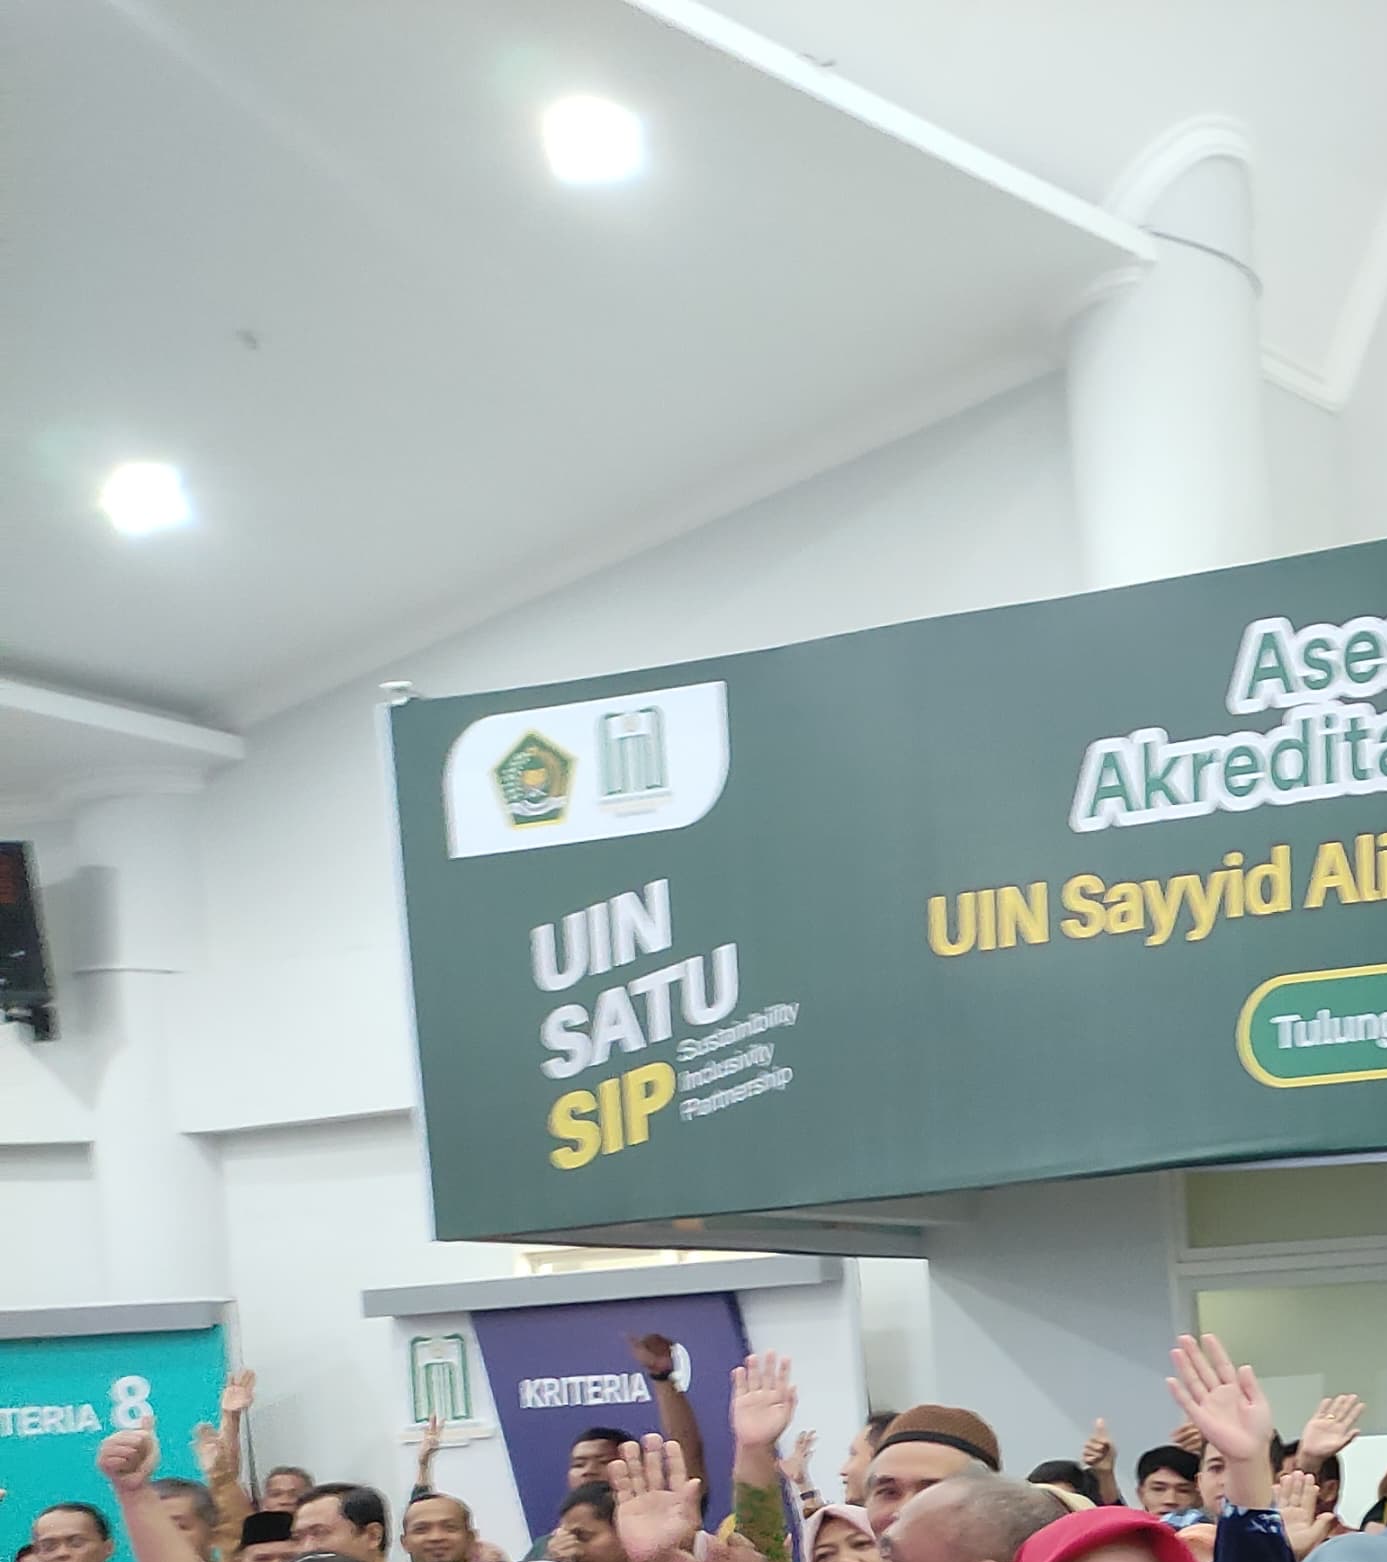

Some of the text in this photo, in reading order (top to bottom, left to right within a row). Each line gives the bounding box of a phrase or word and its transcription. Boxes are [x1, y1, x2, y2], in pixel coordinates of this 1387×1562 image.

[530, 879, 671, 991] UIN
[928, 882, 1048, 956] UIN
[1061, 846, 1291, 945] Sayyid
[541, 943, 738, 1079] SATU
[549, 1062, 675, 1170] SIP
[110, 1375, 154, 1429] 8
[520, 1373, 651, 1408] KRITERIA
